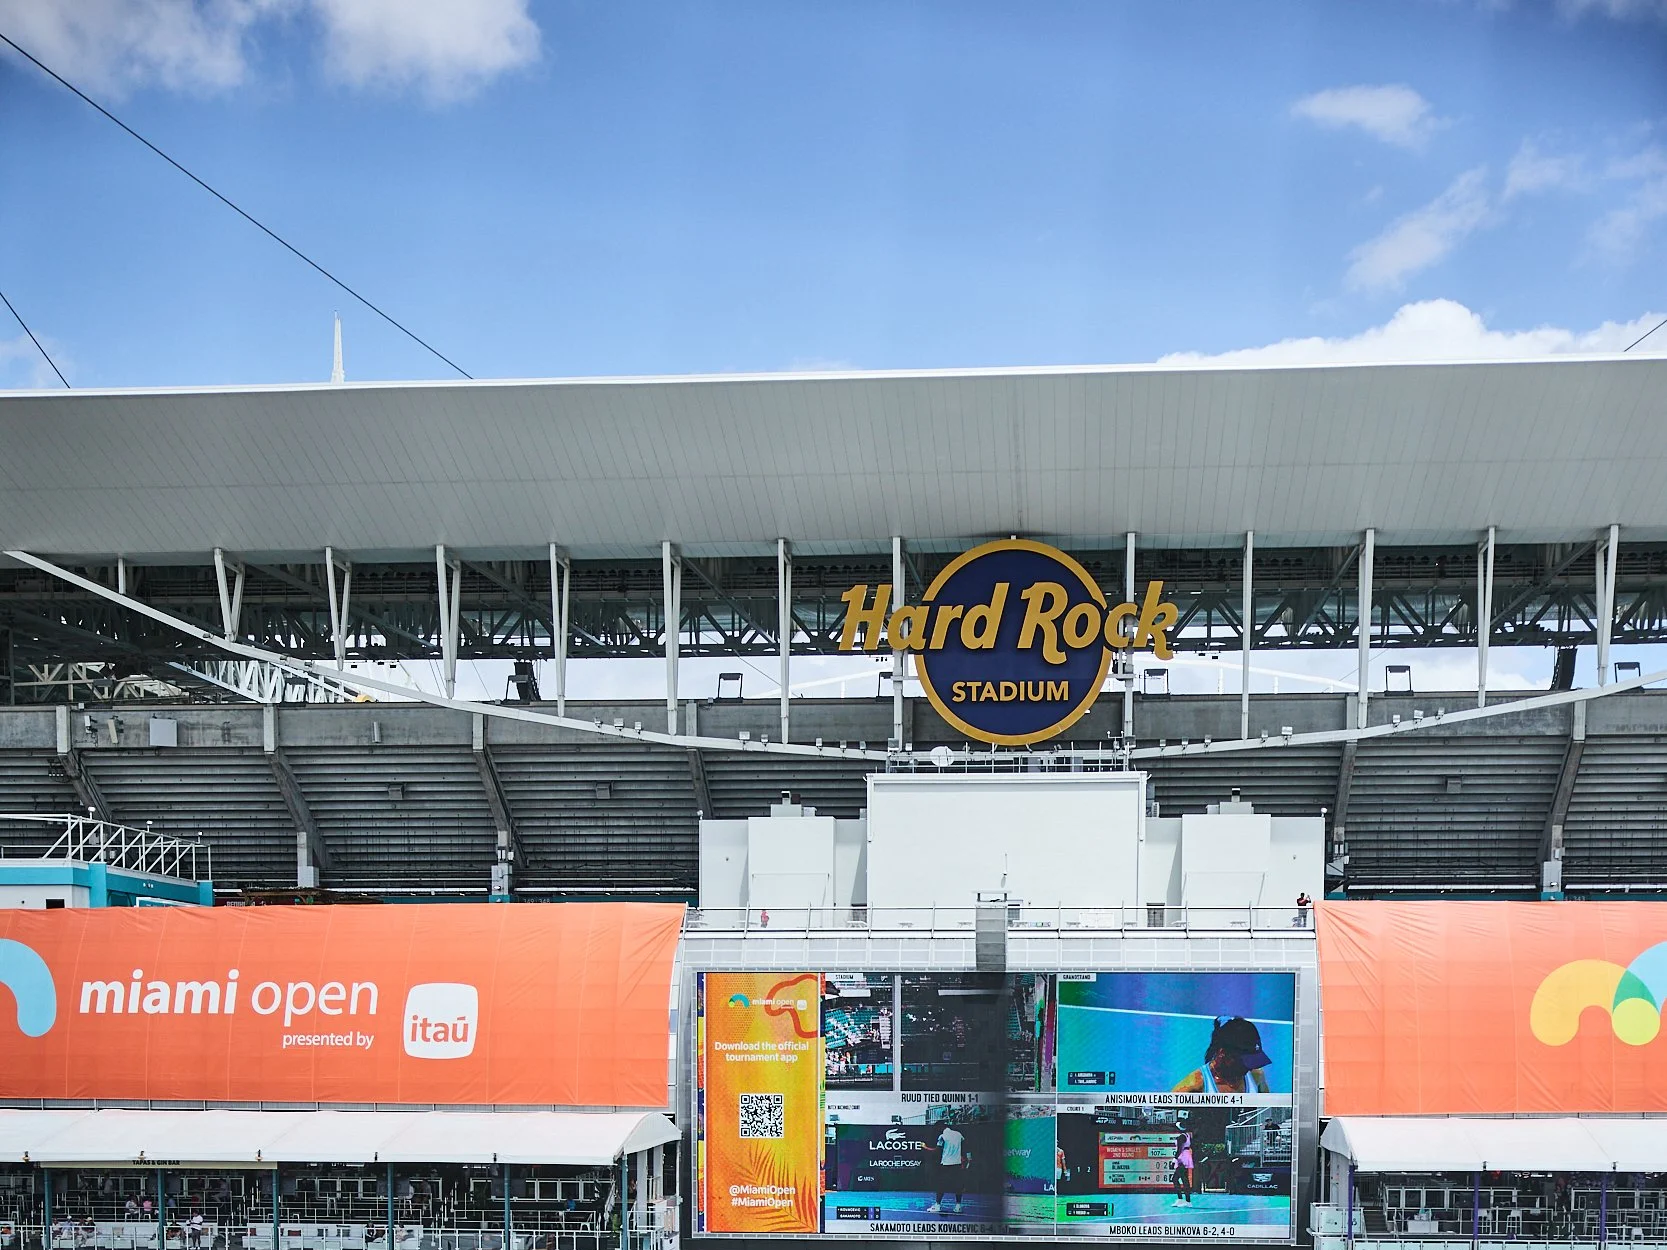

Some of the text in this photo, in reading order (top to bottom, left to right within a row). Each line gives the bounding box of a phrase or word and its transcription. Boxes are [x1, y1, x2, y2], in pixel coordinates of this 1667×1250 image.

[838, 580, 1179, 665] Hard Rock
[952, 680, 1070, 702] STADIUM
[79, 968, 379, 1027] miami open
[410, 1014, 469, 1043] itaú
[282, 1031, 374, 1049] presented by
[714, 1042, 809, 1050] Download the official
[726, 1054, 798, 1064] tournament app
[902, 1094, 978, 1103] RUUD TIED QUINN 1-1
[1105, 1094, 1243, 1104] ANISIMOVA LEADS TOMLJANOVIC 4-1
[870, 1140, 922, 1150] LACOSTE
[729, 1185, 796, 1196] @MiamiOpen
[731, 1197, 793, 1208] #MiamiOpen
[870, 1223, 911, 1232] SAKAMOTO
[913, 1223, 936, 1232] LEADS
[938, 1224, 979, 1233] KOVACEVIC
[1110, 1226, 1235, 1237] MBOKO LEADS BLINKOVA 6-2, 4-0
